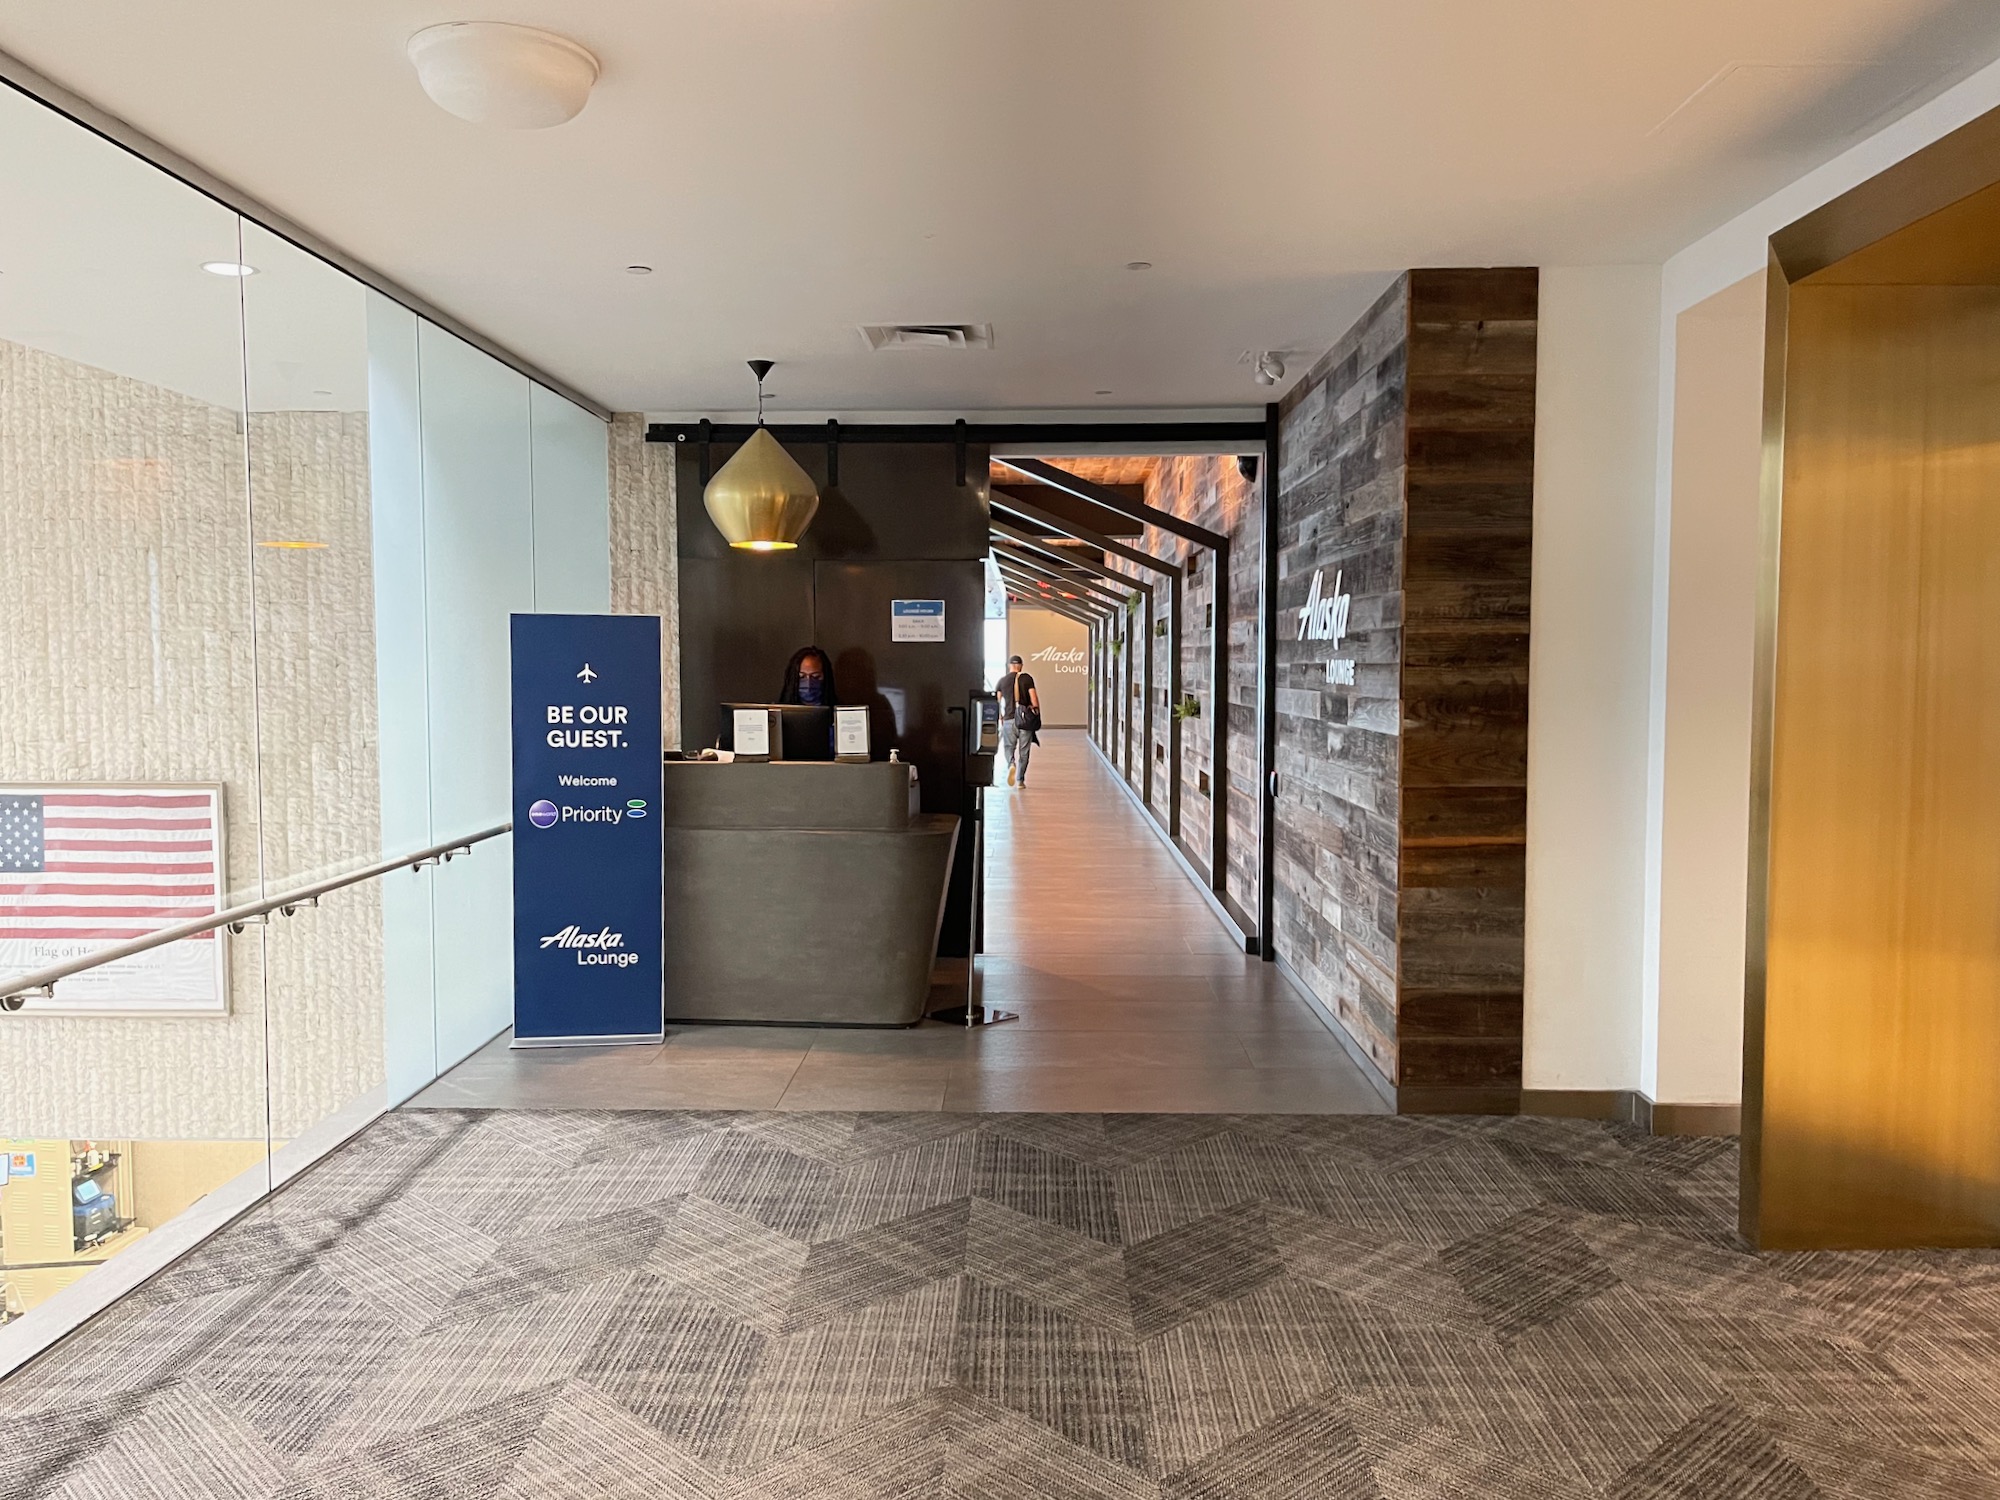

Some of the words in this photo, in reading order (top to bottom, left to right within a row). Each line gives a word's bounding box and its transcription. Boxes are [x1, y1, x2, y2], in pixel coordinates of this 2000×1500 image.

[1298, 569, 1350, 651] Alaska
[1031, 646, 1085, 663] Alaska
[1055, 663, 1089, 675] Loung
[547, 706, 574, 724] BE
[579, 705, 628, 724] OUR
[546, 730, 628, 748] GUEST.
[558, 775, 618, 787] Welcome
[562, 806, 622, 825] Priority
[34, 946, 58, 959] Flag
[61, 946, 74, 957] of
[577, 950, 639, 968] Lounge
